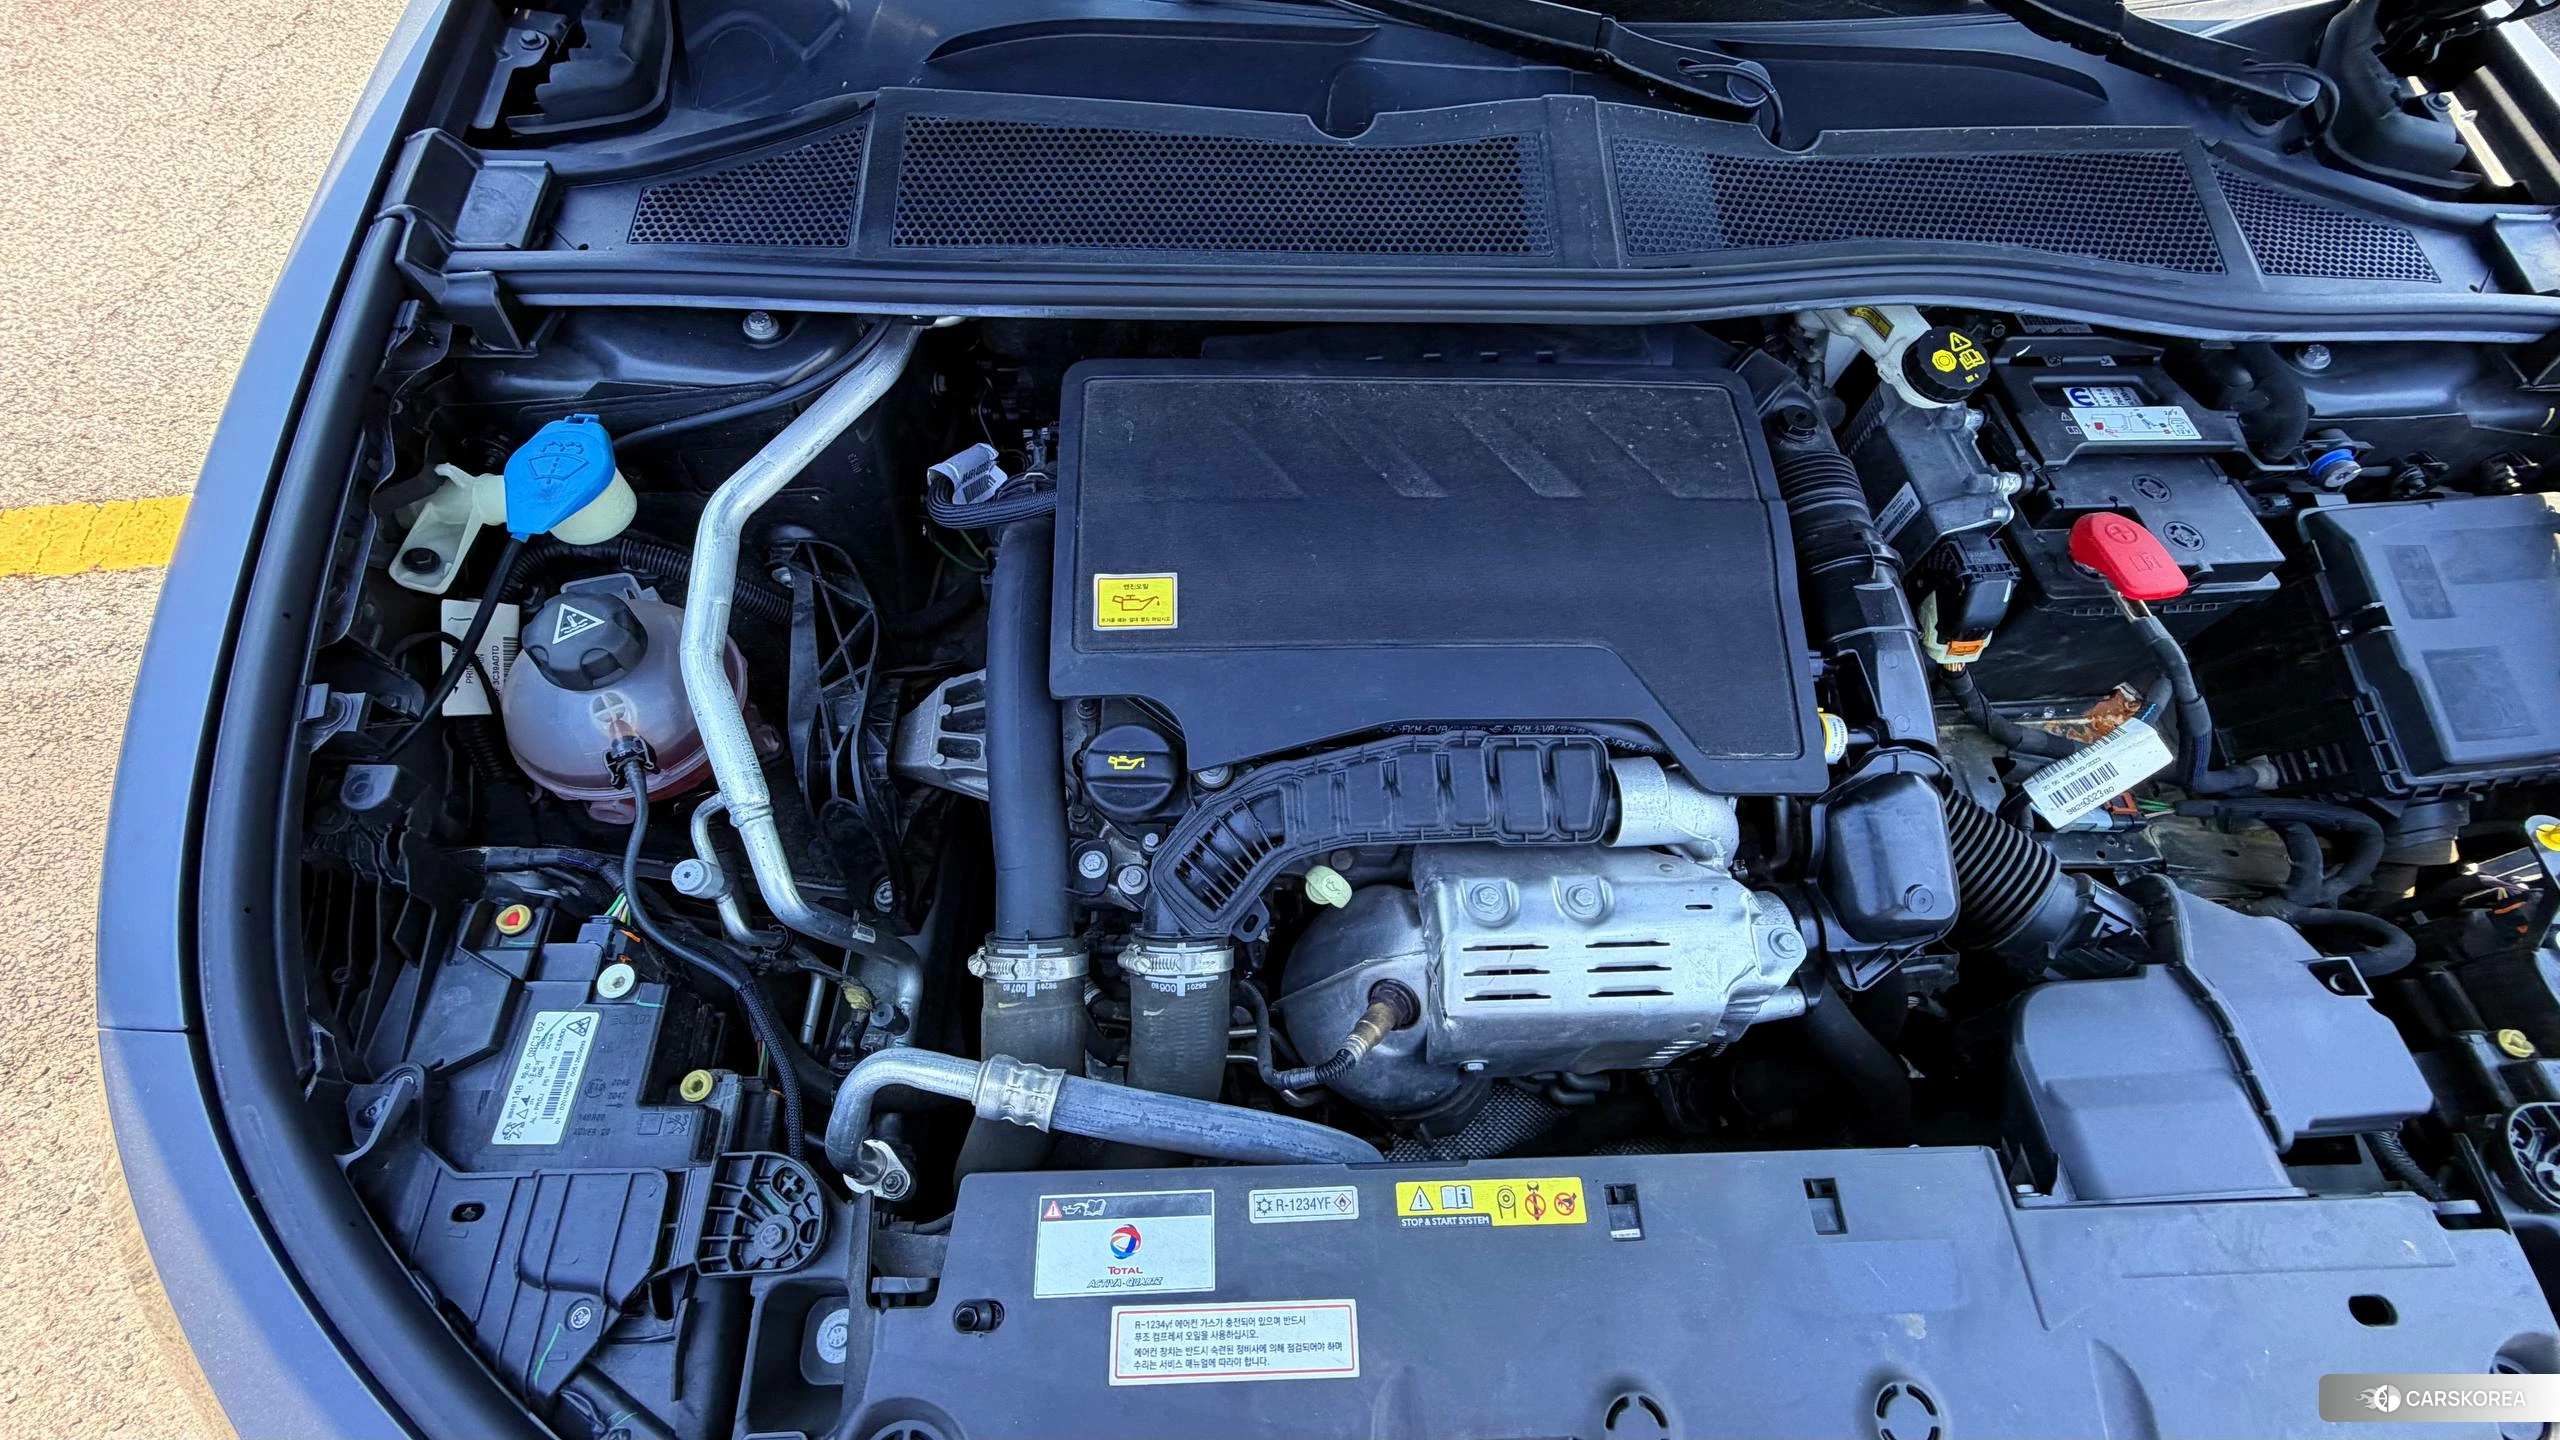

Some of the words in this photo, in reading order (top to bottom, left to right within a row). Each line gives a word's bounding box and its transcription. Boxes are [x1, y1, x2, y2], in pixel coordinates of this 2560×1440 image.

[1276, 1196, 1332, 1212] R-1234YF
[1401, 1217, 1424, 1228] STOP
[1424, 1217, 1431, 1227] &
[1432, 1216, 1457, 1227] START
[1458, 1215, 1490, 1225] SYSTEM
[1108, 1265, 1143, 1275] TOTAL
[1134, 1319, 1173, 1331] R-1234yf
[1174, 1318, 1198, 1329] 에어컨
[1199, 1317, 1223, 1328] 가스가
[1225, 1316, 1256, 1328] 충전되어
[1257, 1315, 1281, 1326] 있으며
[1282, 1315, 1306, 1326] 반드시
[1185, 1330, 1208, 1341] 오일을
[1134, 1346, 1158, 1358] 에어컨
[1159, 1346, 1183, 1358] 장치는
[1185, 1345, 1209, 1357] 반드시
[1210, 1344, 1234, 1356] 숙련된
[1269, 1342, 1285, 1354] 의해
[1287, 1341, 1325, 1354] 점검되어야
[1327, 1341, 1343, 1352] 하며
[1134, 1359, 1157, 1371] 수리는
[1159, 1359, 1183, 1370] 서비스
[1218, 1357, 1242, 1368] 따라야
[1244, 1356, 1270, 1368] 합니다.
